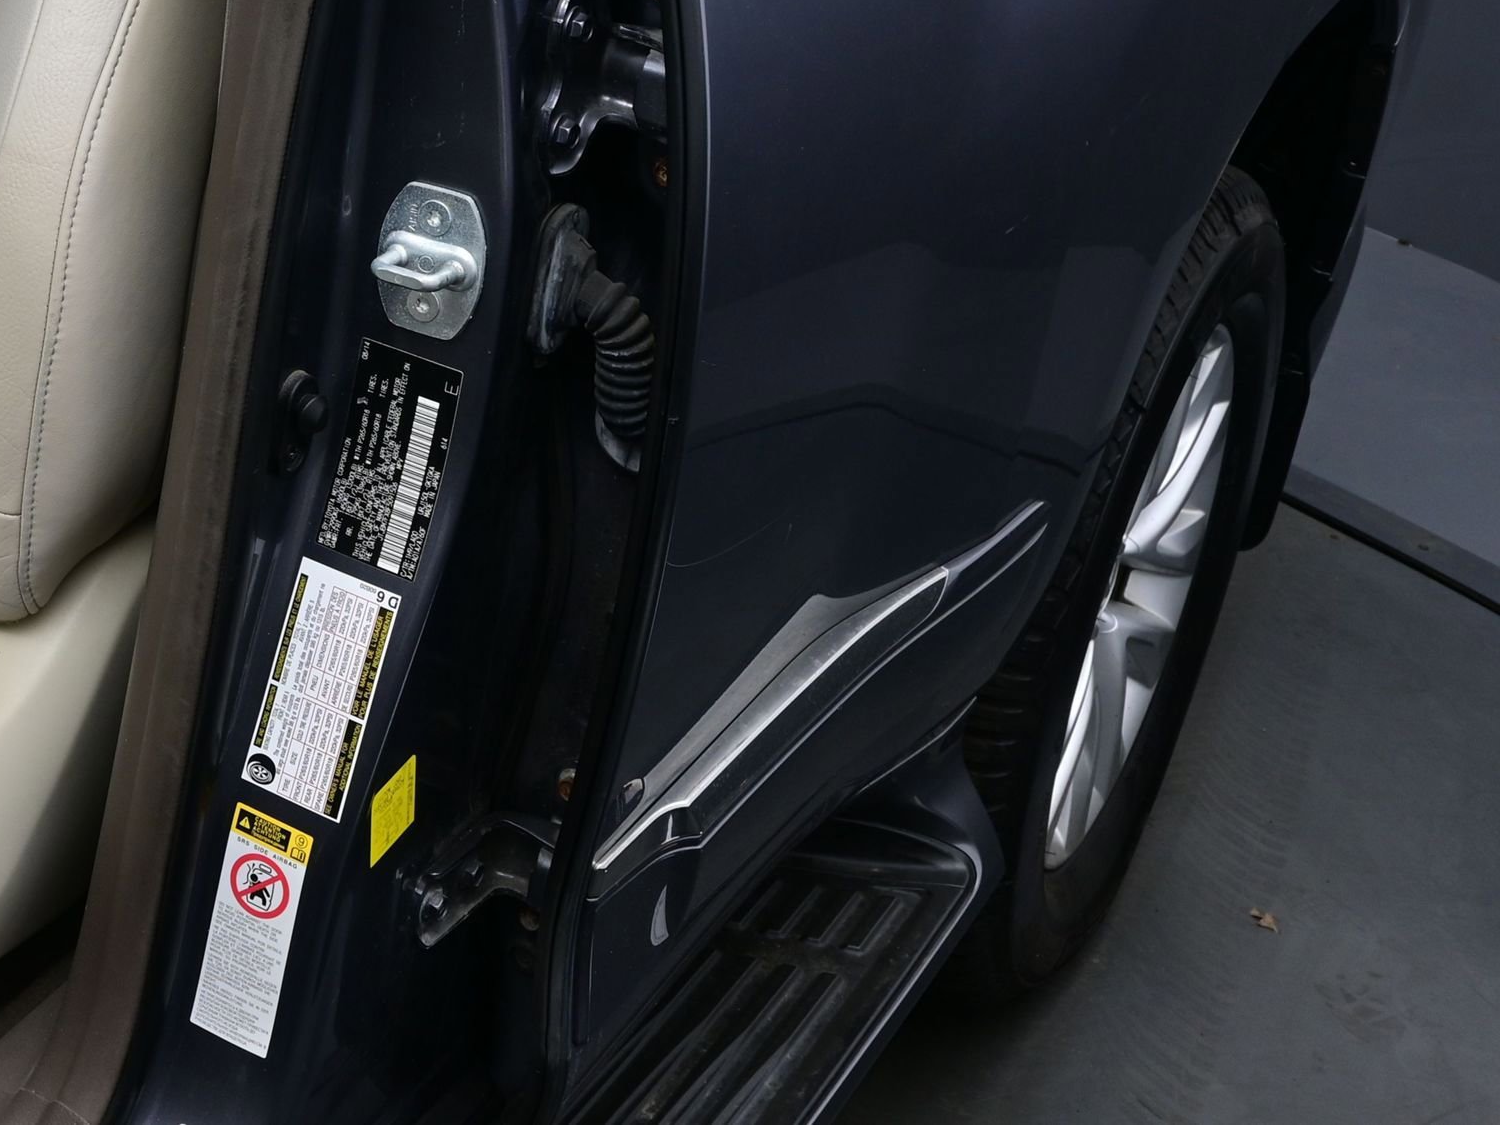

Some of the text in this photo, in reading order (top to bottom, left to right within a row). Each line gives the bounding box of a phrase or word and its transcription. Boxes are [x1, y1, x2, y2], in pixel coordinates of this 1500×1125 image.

[443, 380, 459, 396] E
[356, 408, 370, 444] P265/60R18
[368, 412, 382, 448] P265/60R18
[309, 633, 330, 691] PNEU DIMENSIONS
[320, 678, 330, 698] AVANT
[351, 699, 360, 715] VOIR
[359, 660, 371, 687] MANUEL
[363, 681, 372, 698] PLUS
[334, 755, 345, 777] MANUAL
[253, 820, 286, 840] ATTENTION
[253, 825, 280, 842] ACHTUNG
[254, 815, 281, 832] CAUTION
[236, 836, 297, 869] SRS SIDE AIRBAG
